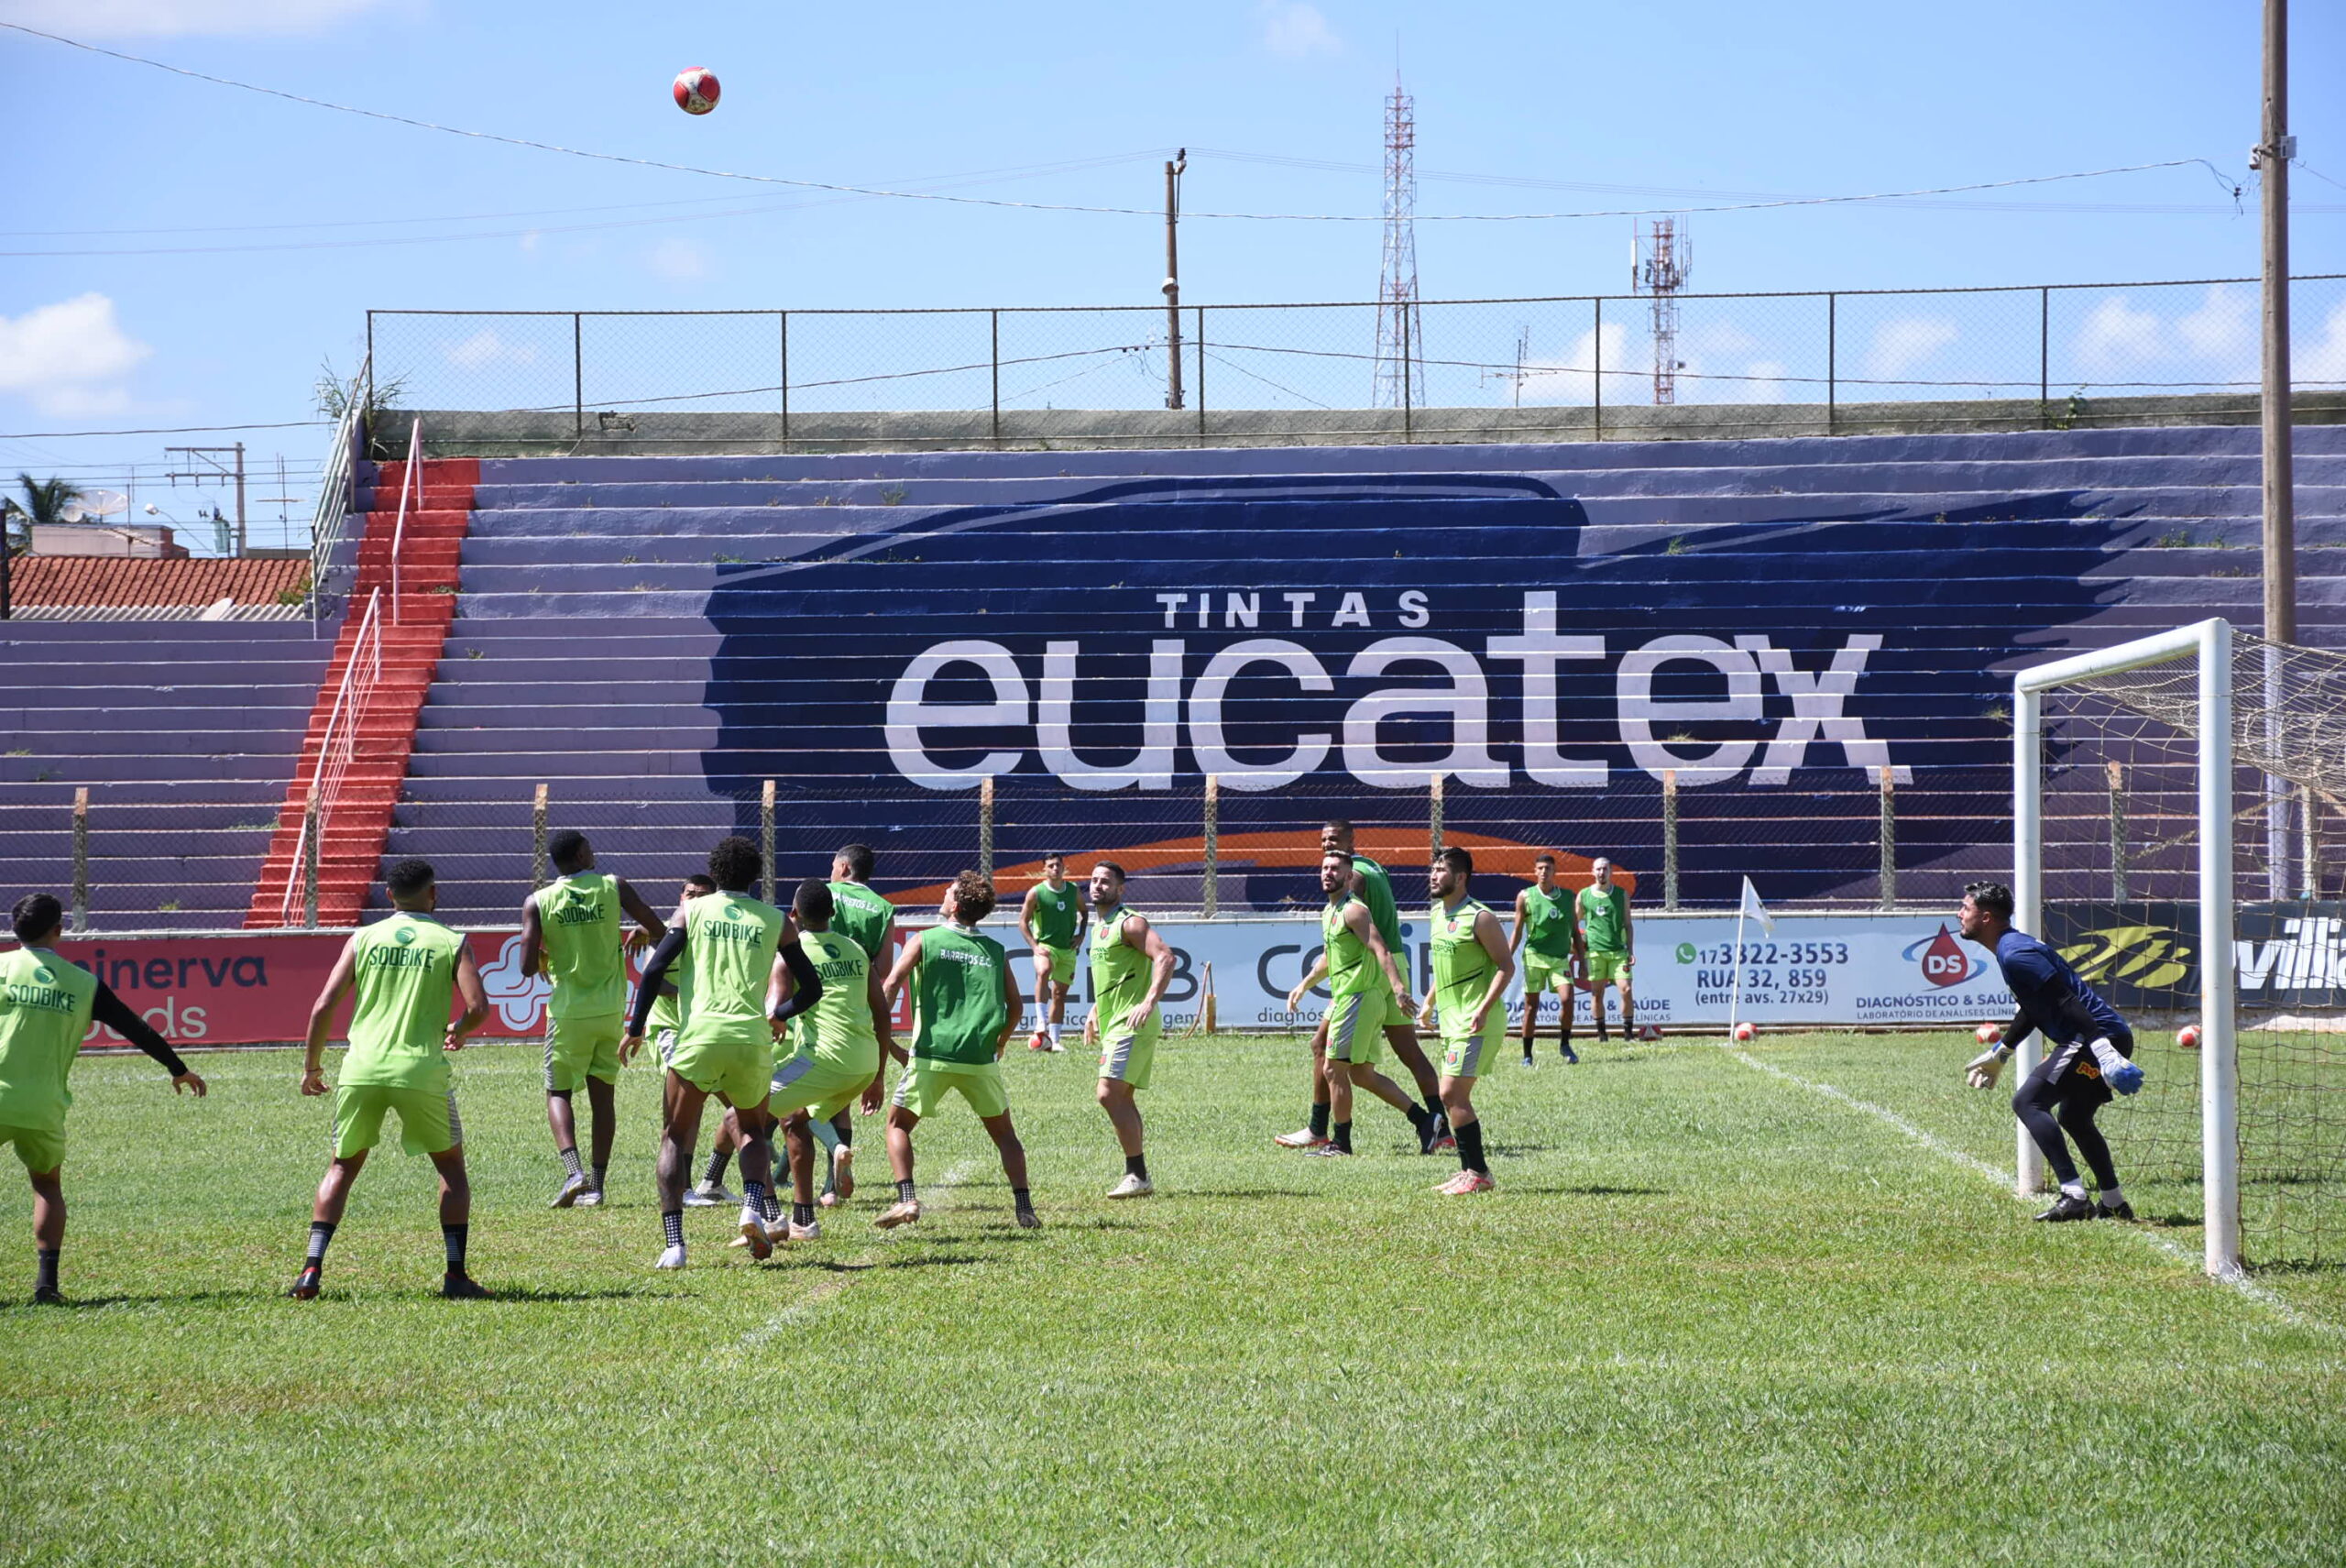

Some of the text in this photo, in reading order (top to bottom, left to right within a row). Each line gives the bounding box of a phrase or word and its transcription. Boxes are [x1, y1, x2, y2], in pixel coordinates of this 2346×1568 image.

[1157, 590, 1430, 628] TINTAS
[884, 590, 1913, 790] eucatex
[704, 920, 762, 944] SODBIKE
[369, 945, 435, 968] SODBIKE
[940, 948, 978, 965] BARRETOS
[1928, 955, 1963, 974] DS
[73, 948, 268, 990] inerva
[814, 959, 863, 981] SODBIKE
[1697, 969, 1827, 991] RUA 32, 859
[7, 984, 75, 1012] SODBIKE
[1606, 1000, 1617, 1011] &
[1632, 996, 1671, 1011] AÚDE
[1695, 990, 1829, 1005] (entre avs. 27x29)
[1857, 993, 1959, 1008] DIAGNÓSTICO
[1963, 994, 1973, 1006] &
[1857, 1008, 1924, 1020] LABORATÓRIO
[1925, 1010, 1937, 1018] DE
